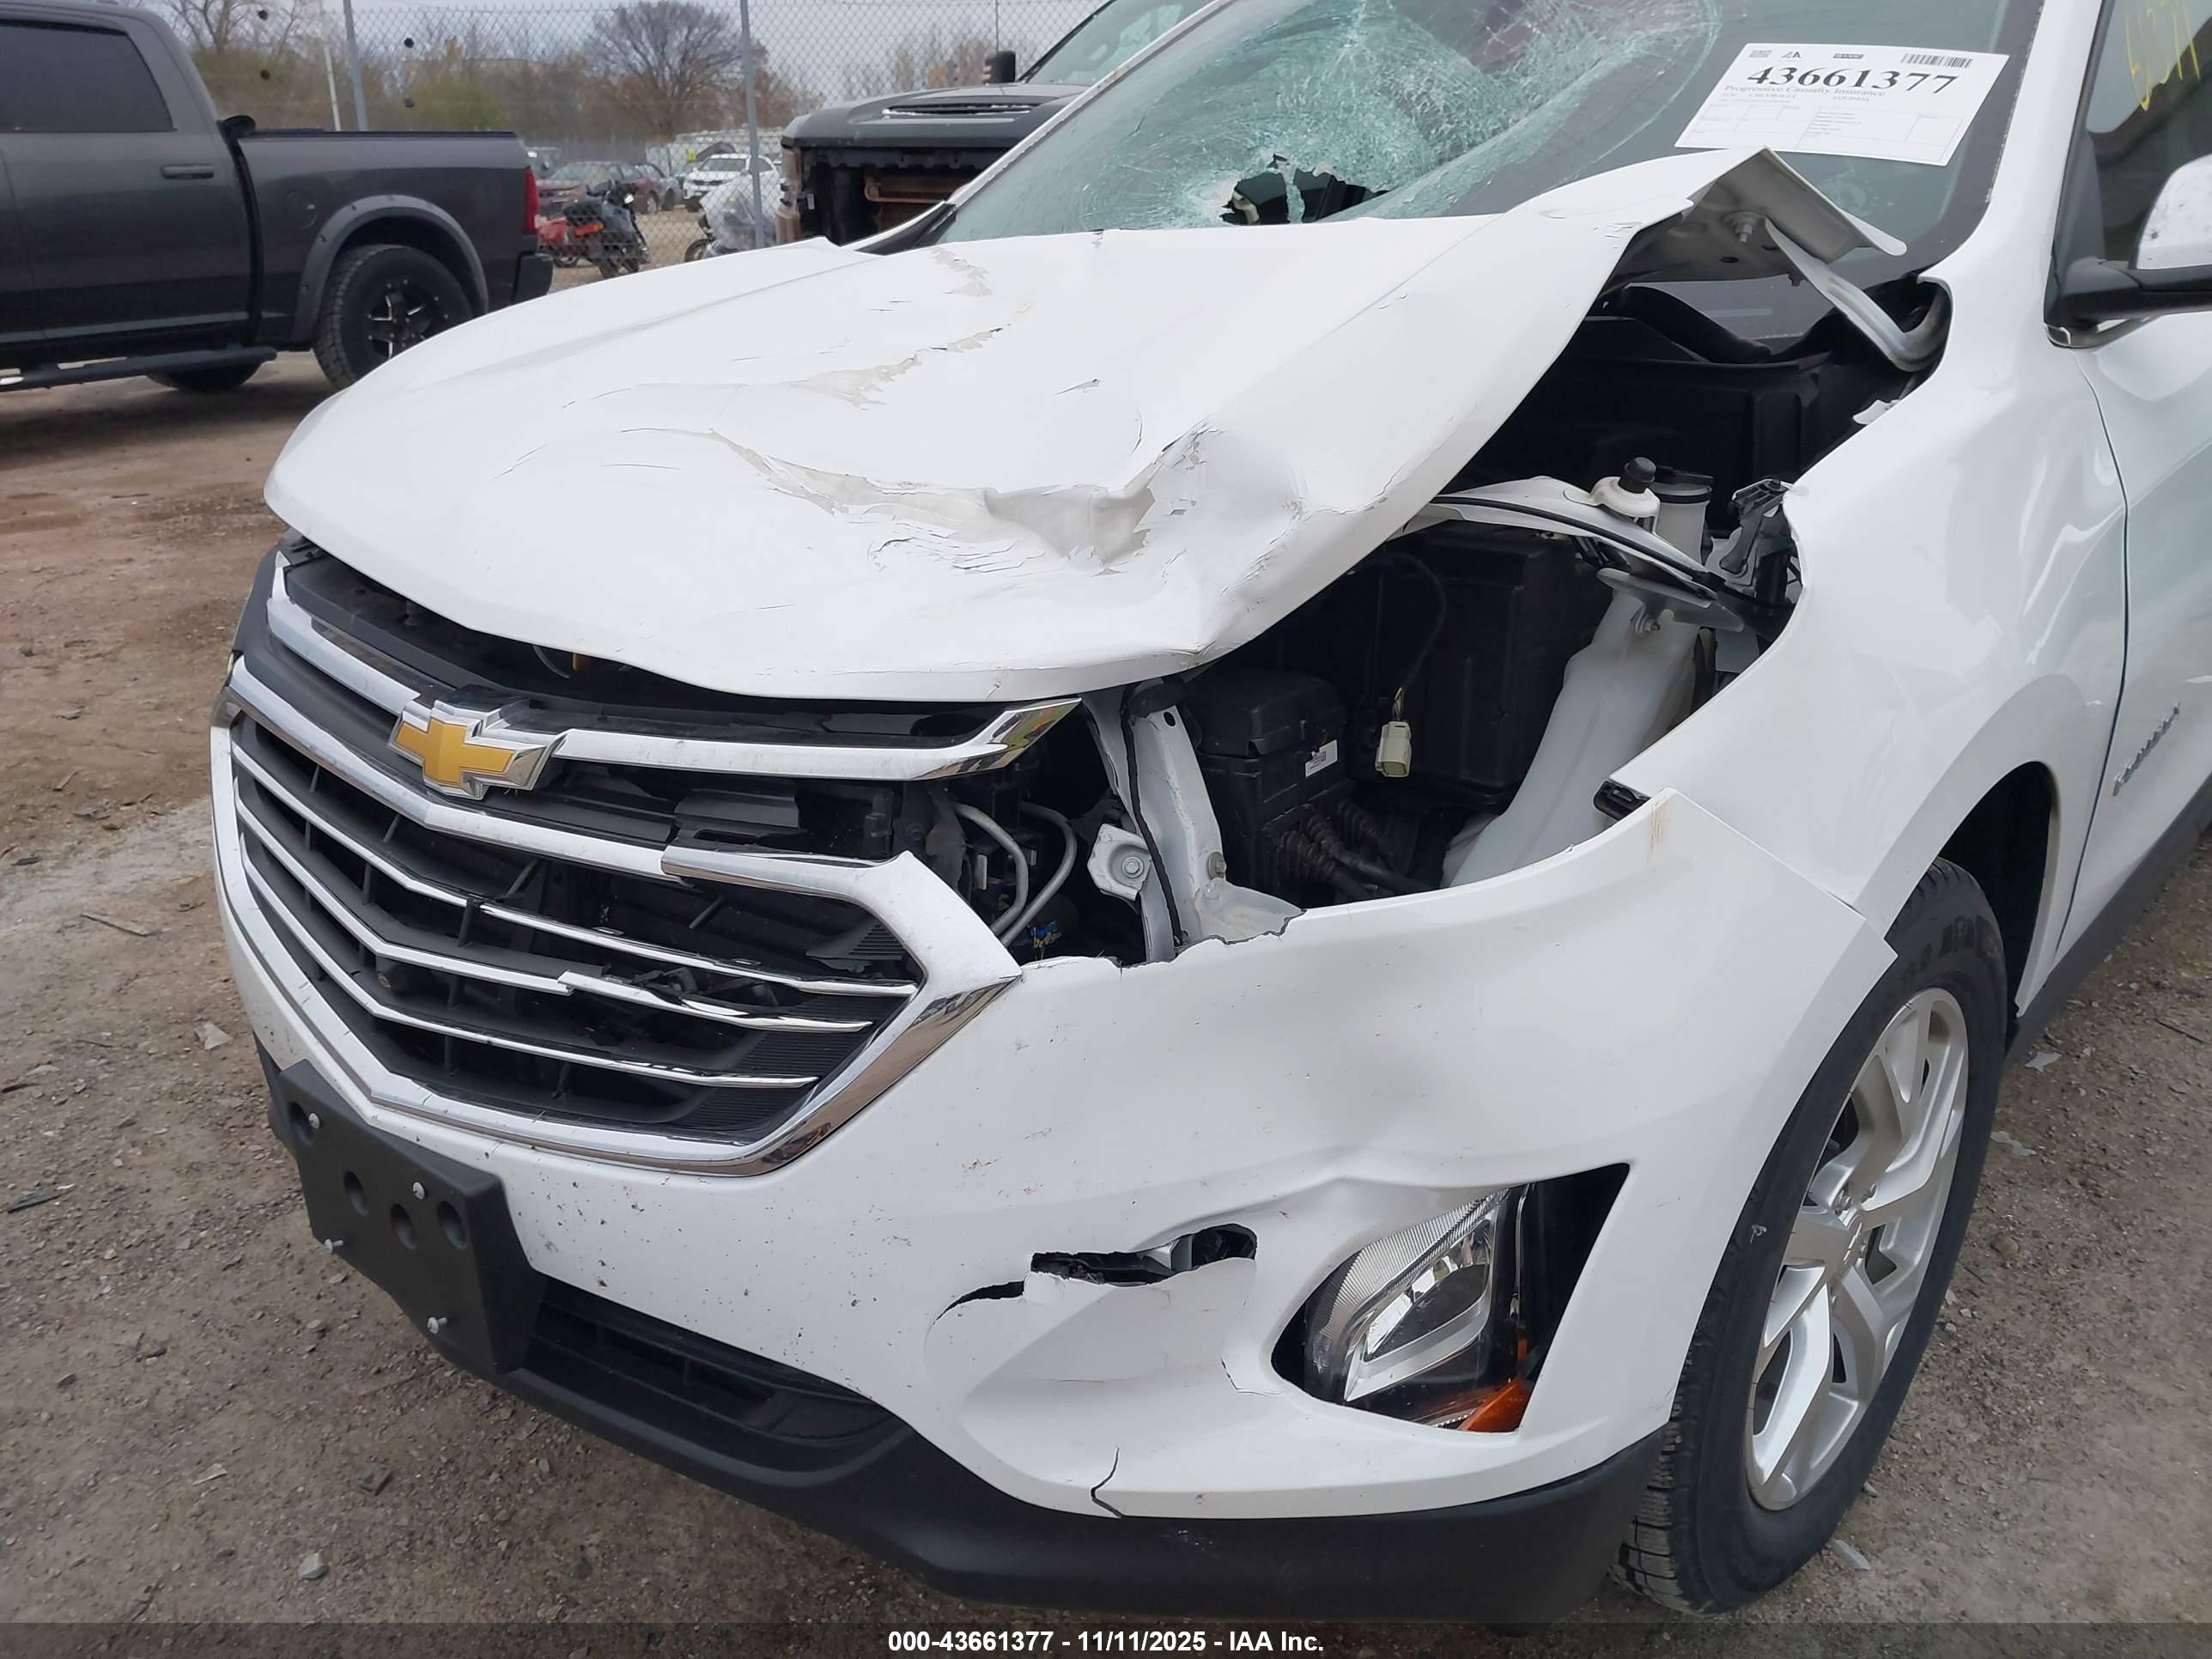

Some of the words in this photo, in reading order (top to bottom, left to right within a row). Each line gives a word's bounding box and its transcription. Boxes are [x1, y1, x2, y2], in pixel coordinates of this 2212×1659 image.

[1747, 66, 1960, 94] 43661377
[1786, 87, 1828, 95] Casualty
[1834, 88, 1886, 97] Insurance
